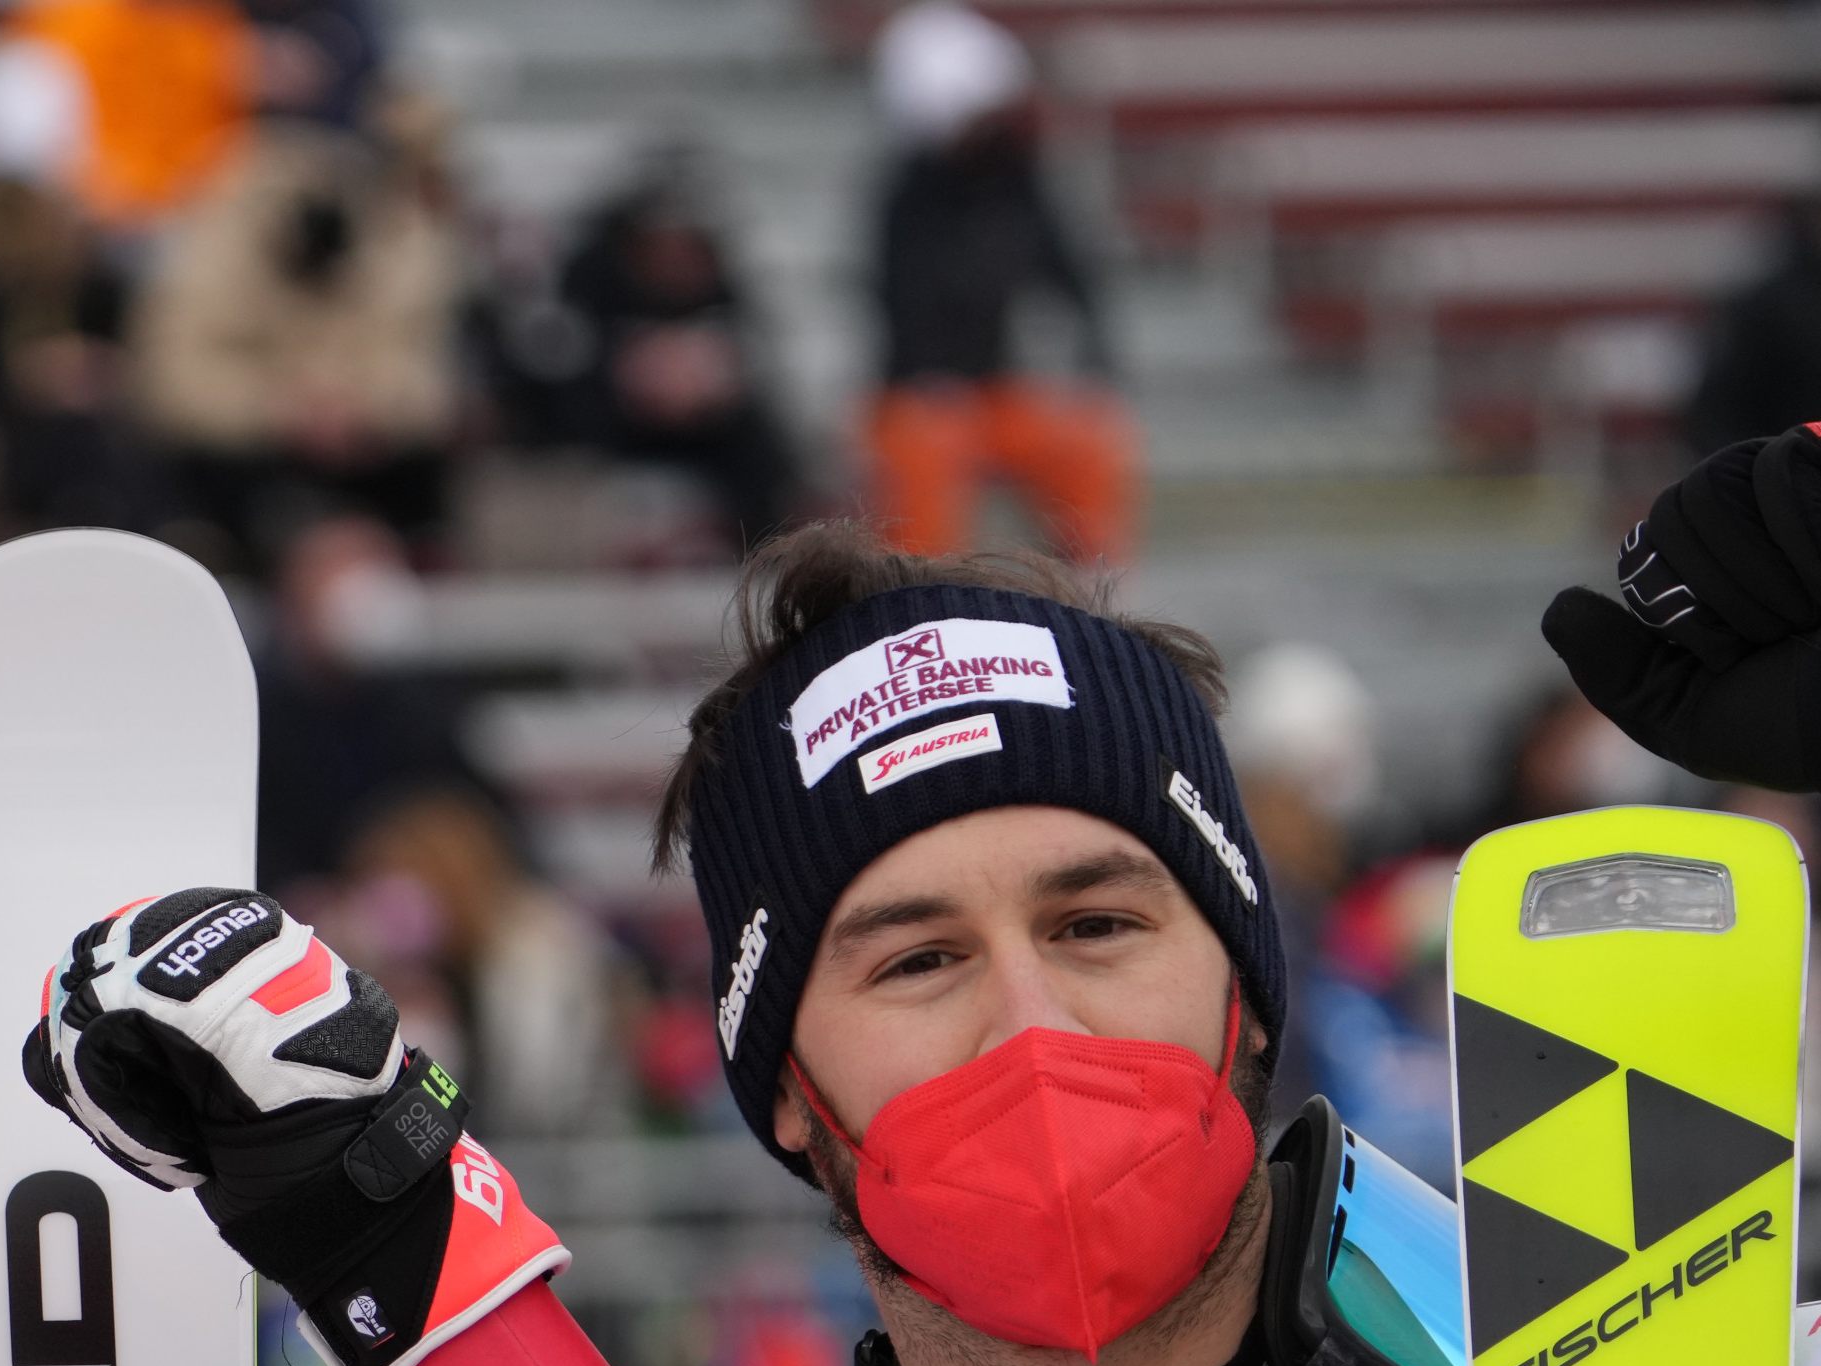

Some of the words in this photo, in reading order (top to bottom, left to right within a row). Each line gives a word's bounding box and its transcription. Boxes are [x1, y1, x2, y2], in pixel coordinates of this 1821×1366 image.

[806, 674, 909, 756] PRIVATE
[917, 656, 1053, 688] BANKING
[851, 678, 995, 742] ATTERSEE
[157, 901, 269, 977] reusch
[394, 1114, 436, 1160] SIZE
[409, 1102, 448, 1145] ONE
